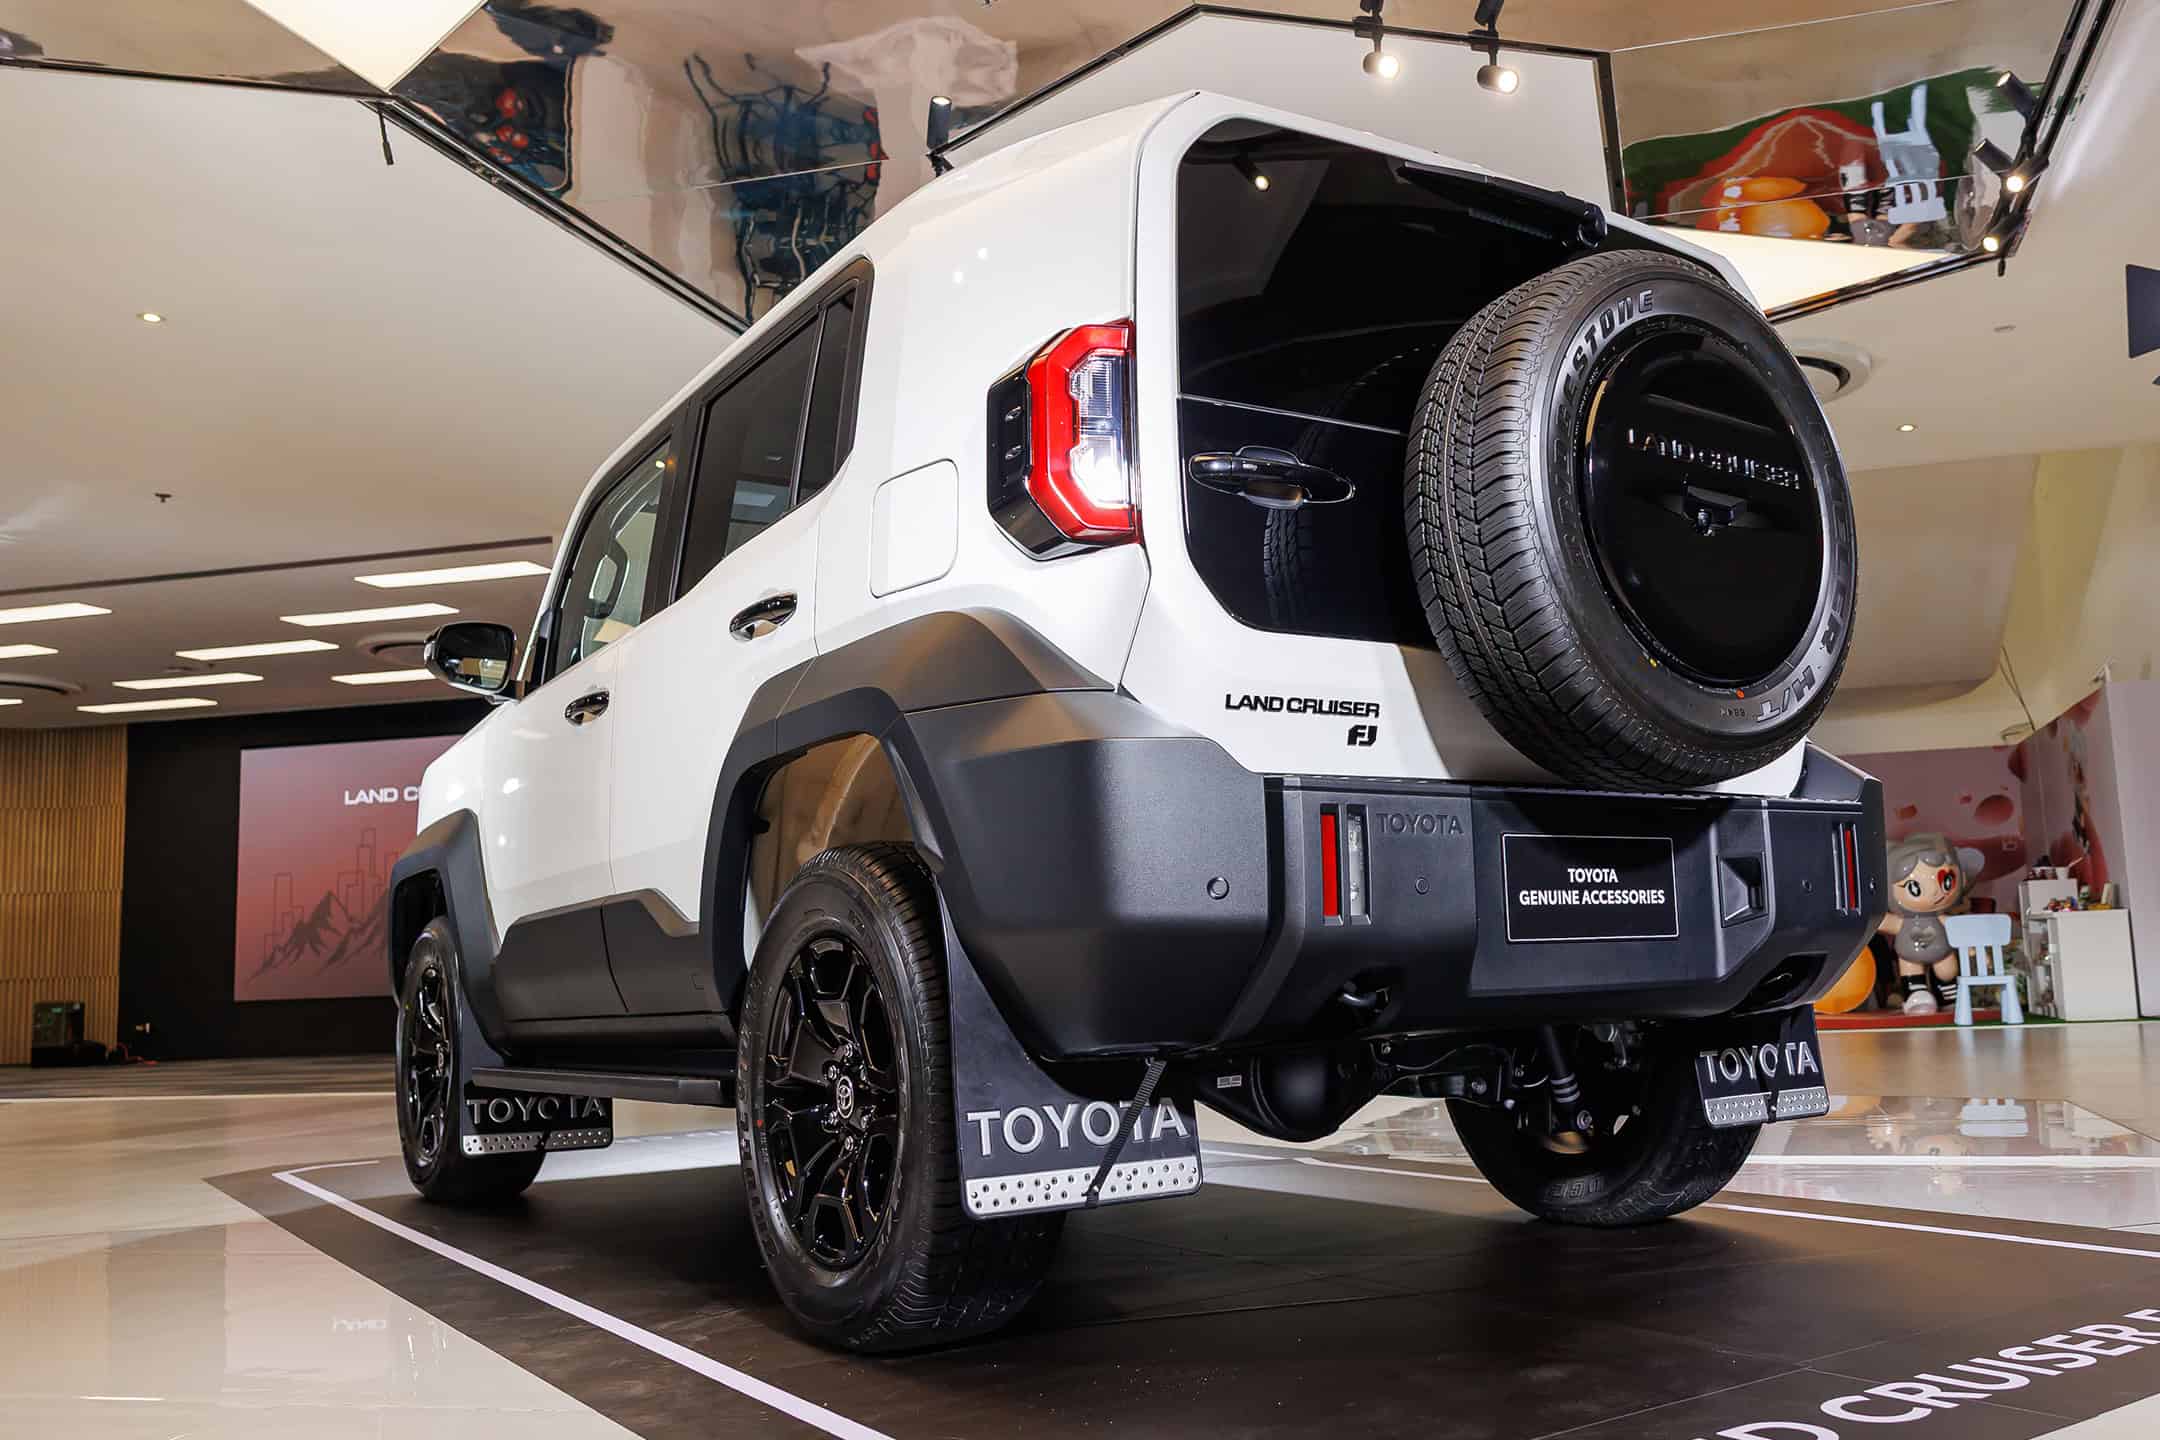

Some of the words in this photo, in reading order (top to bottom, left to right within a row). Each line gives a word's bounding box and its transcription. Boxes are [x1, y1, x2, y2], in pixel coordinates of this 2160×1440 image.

[1628, 428, 1694, 463] LAND
[1225, 693, 1284, 712] LAND
[1286, 697, 1380, 718] CRUISER
[1757, 664, 1816, 723] H/T
[1347, 725, 1377, 746] FJ
[343, 787, 399, 806] LAND
[1376, 813, 1464, 835] TOYOTA
[1567, 868, 1619, 883] TOYOTA
[1519, 890, 1580, 906] GENUINE
[1582, 889, 1666, 905] ACCESSORIES
[1699, 1041, 1819, 1084] TOYOTA
[466, 1096, 607, 1125] TOYOTA
[967, 1097, 1190, 1156] TOYOTA
[1820, 1324, 2160, 1423] CRUISER
